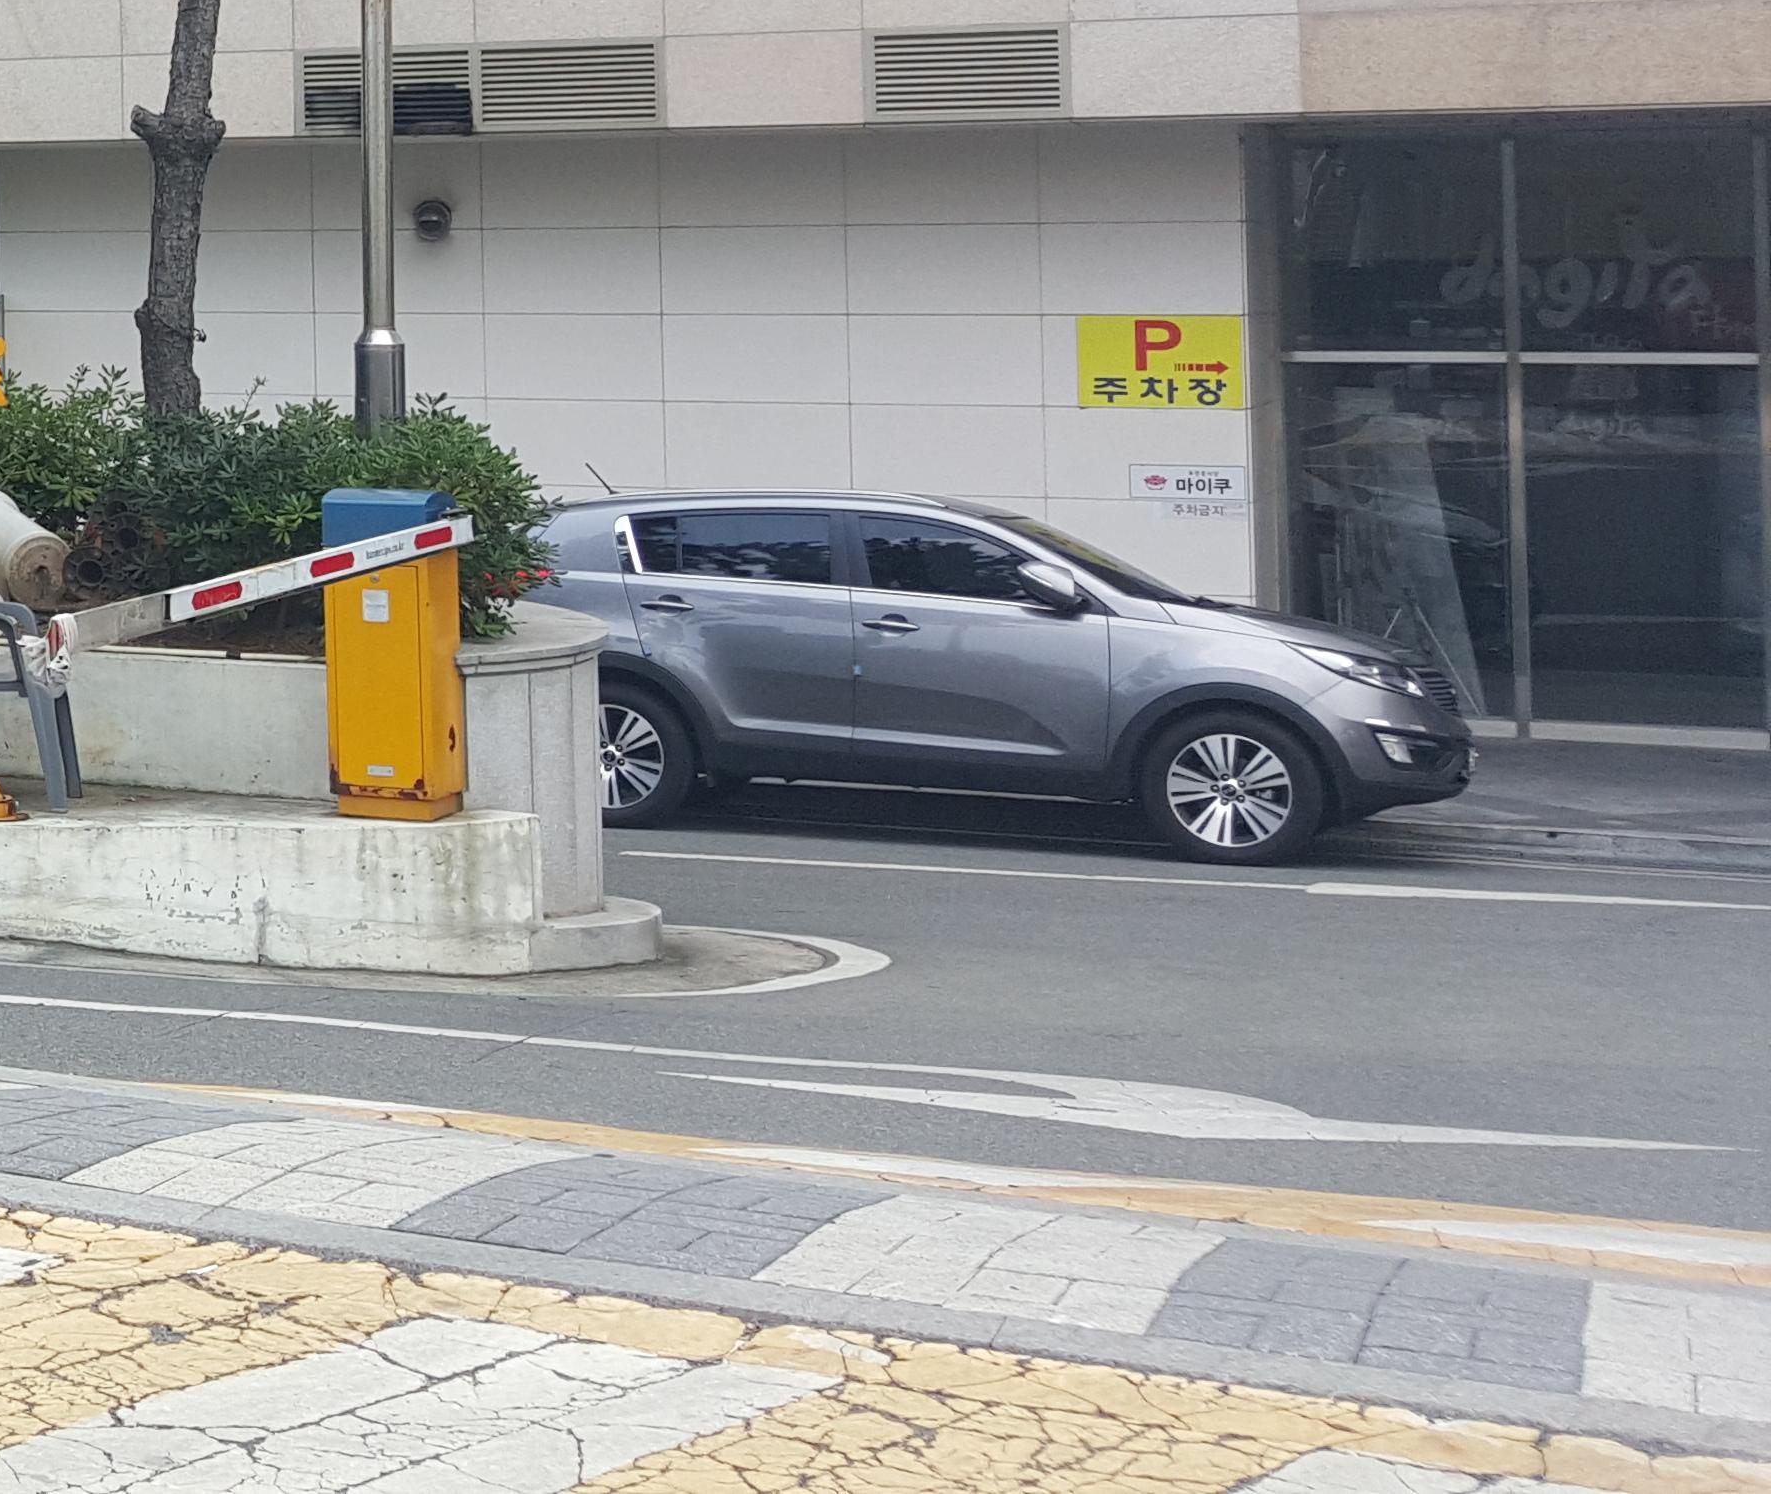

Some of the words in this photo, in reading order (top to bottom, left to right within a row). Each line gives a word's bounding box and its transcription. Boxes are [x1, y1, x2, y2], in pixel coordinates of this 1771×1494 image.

[1134, 319, 1182, 372] P
[1093, 376, 1227, 406] 주차장
[1175, 477, 1233, 495] 마이쿠
[1172, 504, 1226, 517] 주차금지
